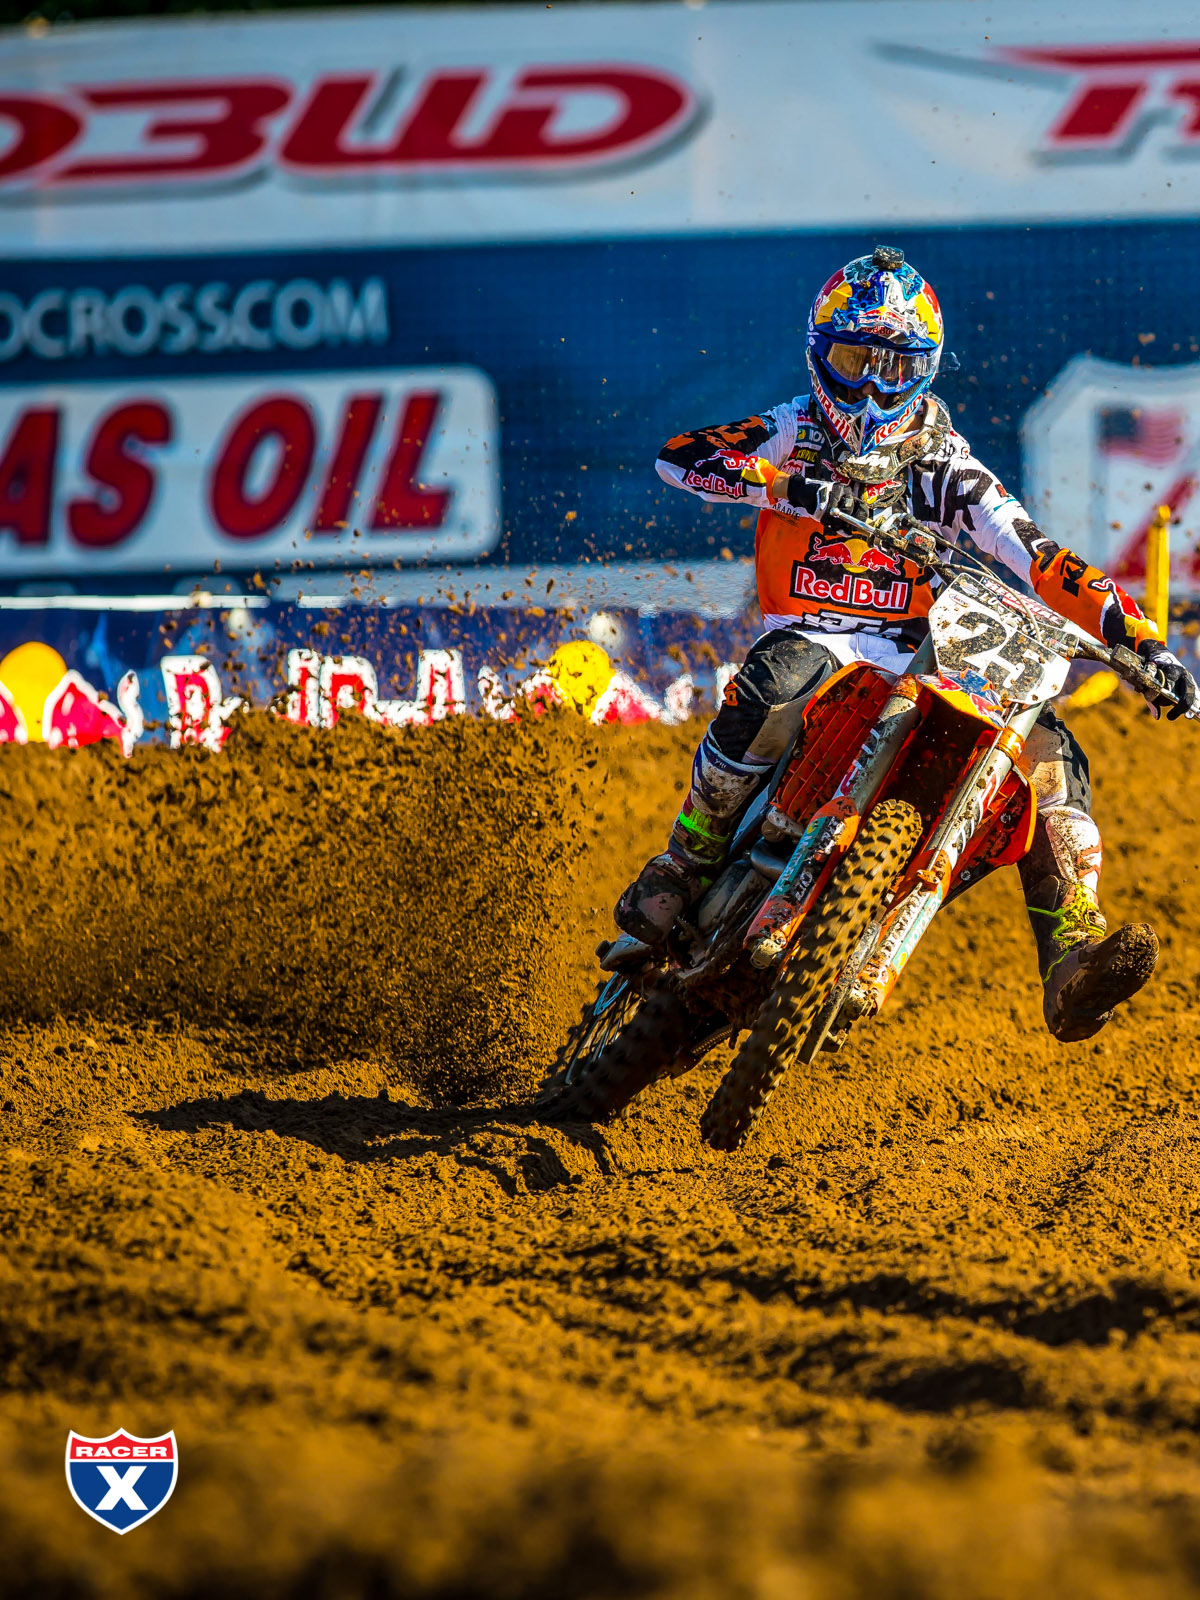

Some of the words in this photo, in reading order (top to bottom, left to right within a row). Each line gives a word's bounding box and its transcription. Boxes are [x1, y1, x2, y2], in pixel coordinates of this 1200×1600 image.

[208, 392, 453, 542] OIL
[713, 473, 744, 498] Bull
[795, 565, 852, 604] Red
[852, 576, 909, 610] Bull
[937, 611, 1056, 701] 25
